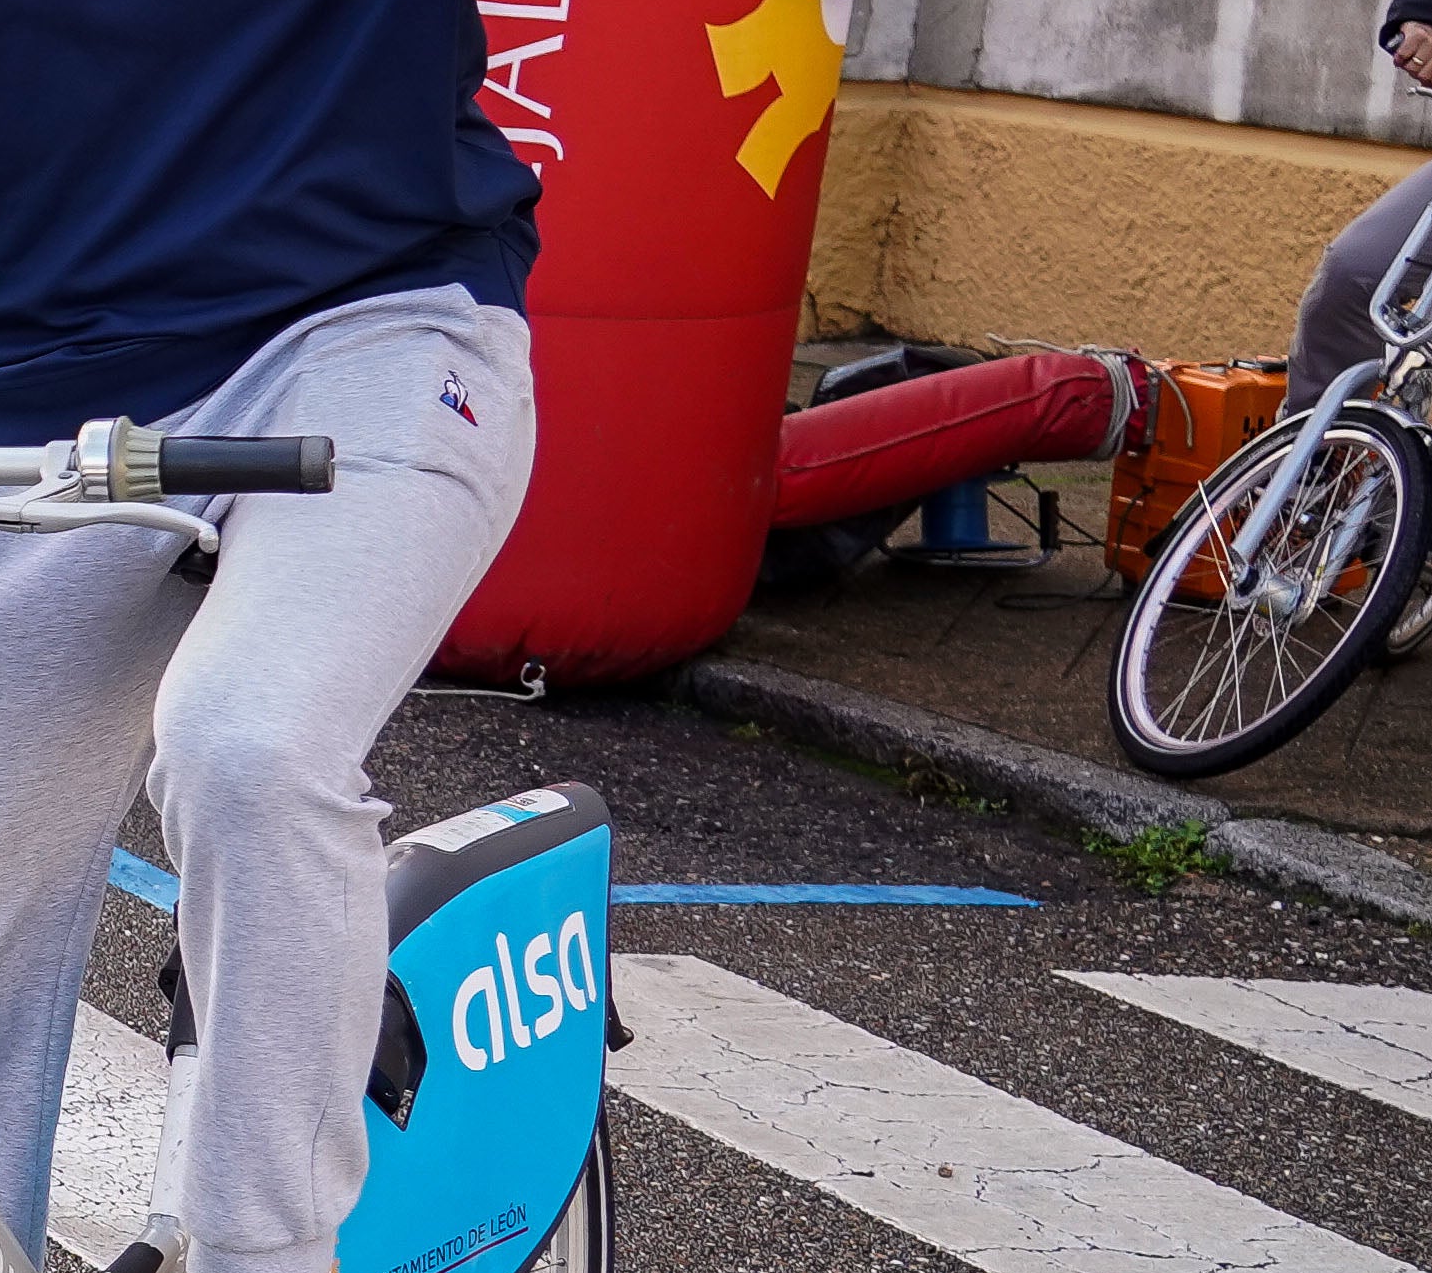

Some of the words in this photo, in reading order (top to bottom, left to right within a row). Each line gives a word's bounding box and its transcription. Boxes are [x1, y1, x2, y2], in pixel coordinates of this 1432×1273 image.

[452, 910, 598, 1072] alsa
[467, 1222, 487, 1250] DE
[490, 1201, 528, 1237] LEÓN
